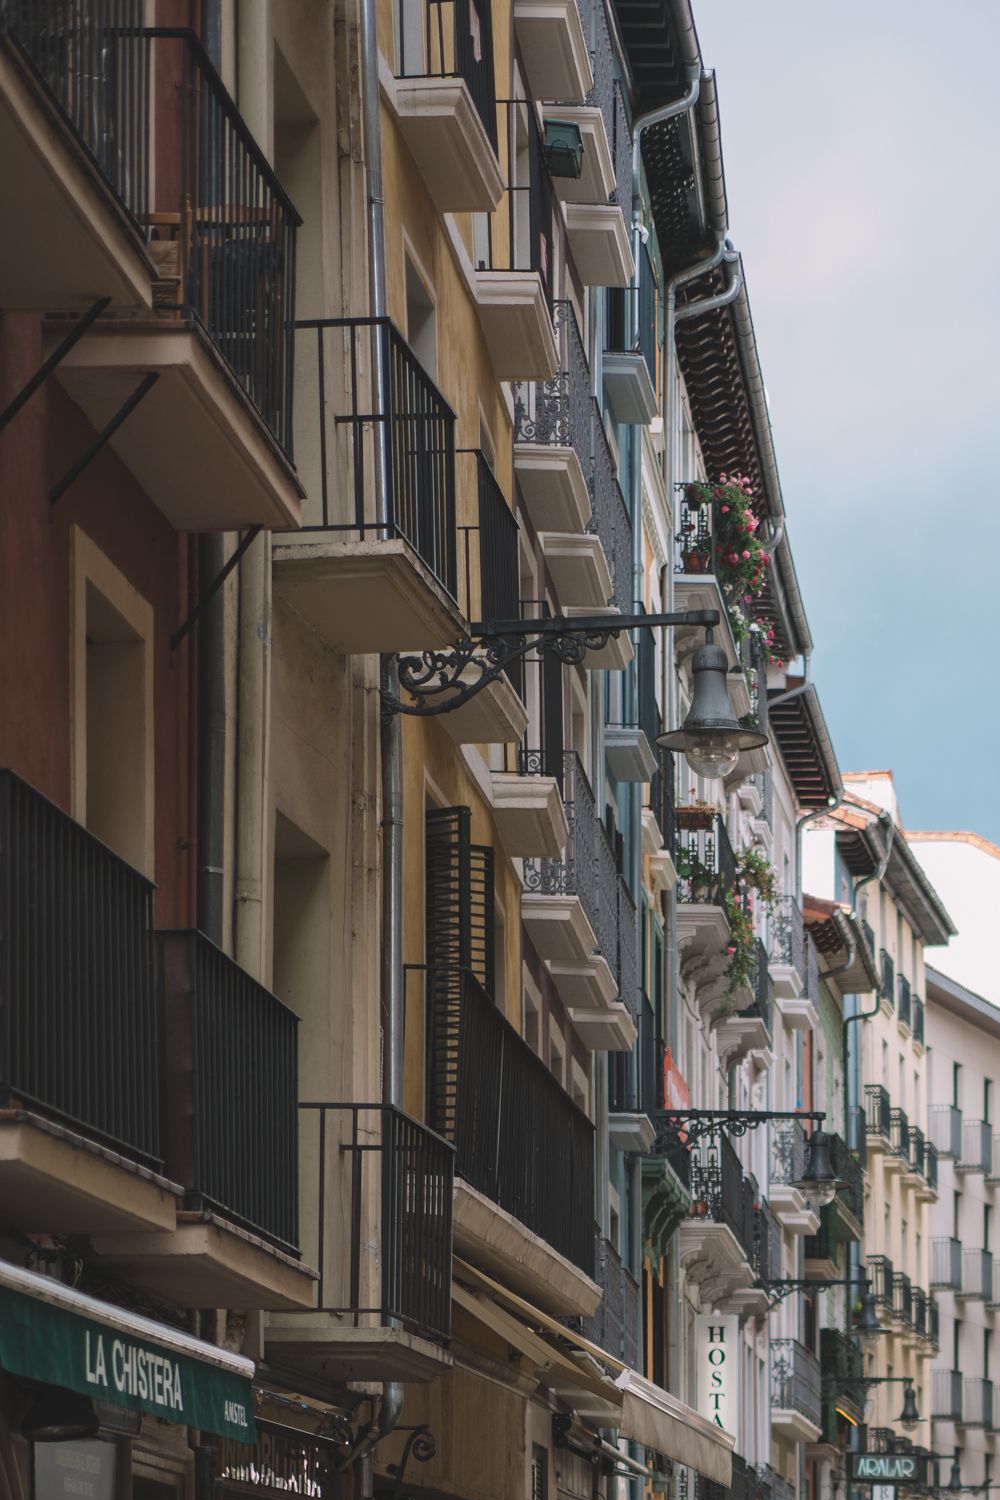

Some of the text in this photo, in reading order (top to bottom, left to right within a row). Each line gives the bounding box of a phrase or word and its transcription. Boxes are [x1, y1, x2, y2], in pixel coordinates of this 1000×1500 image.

[85, 1330, 184, 1412] LA CHISTERA
[856, 1457, 915, 1478] ARALAR
